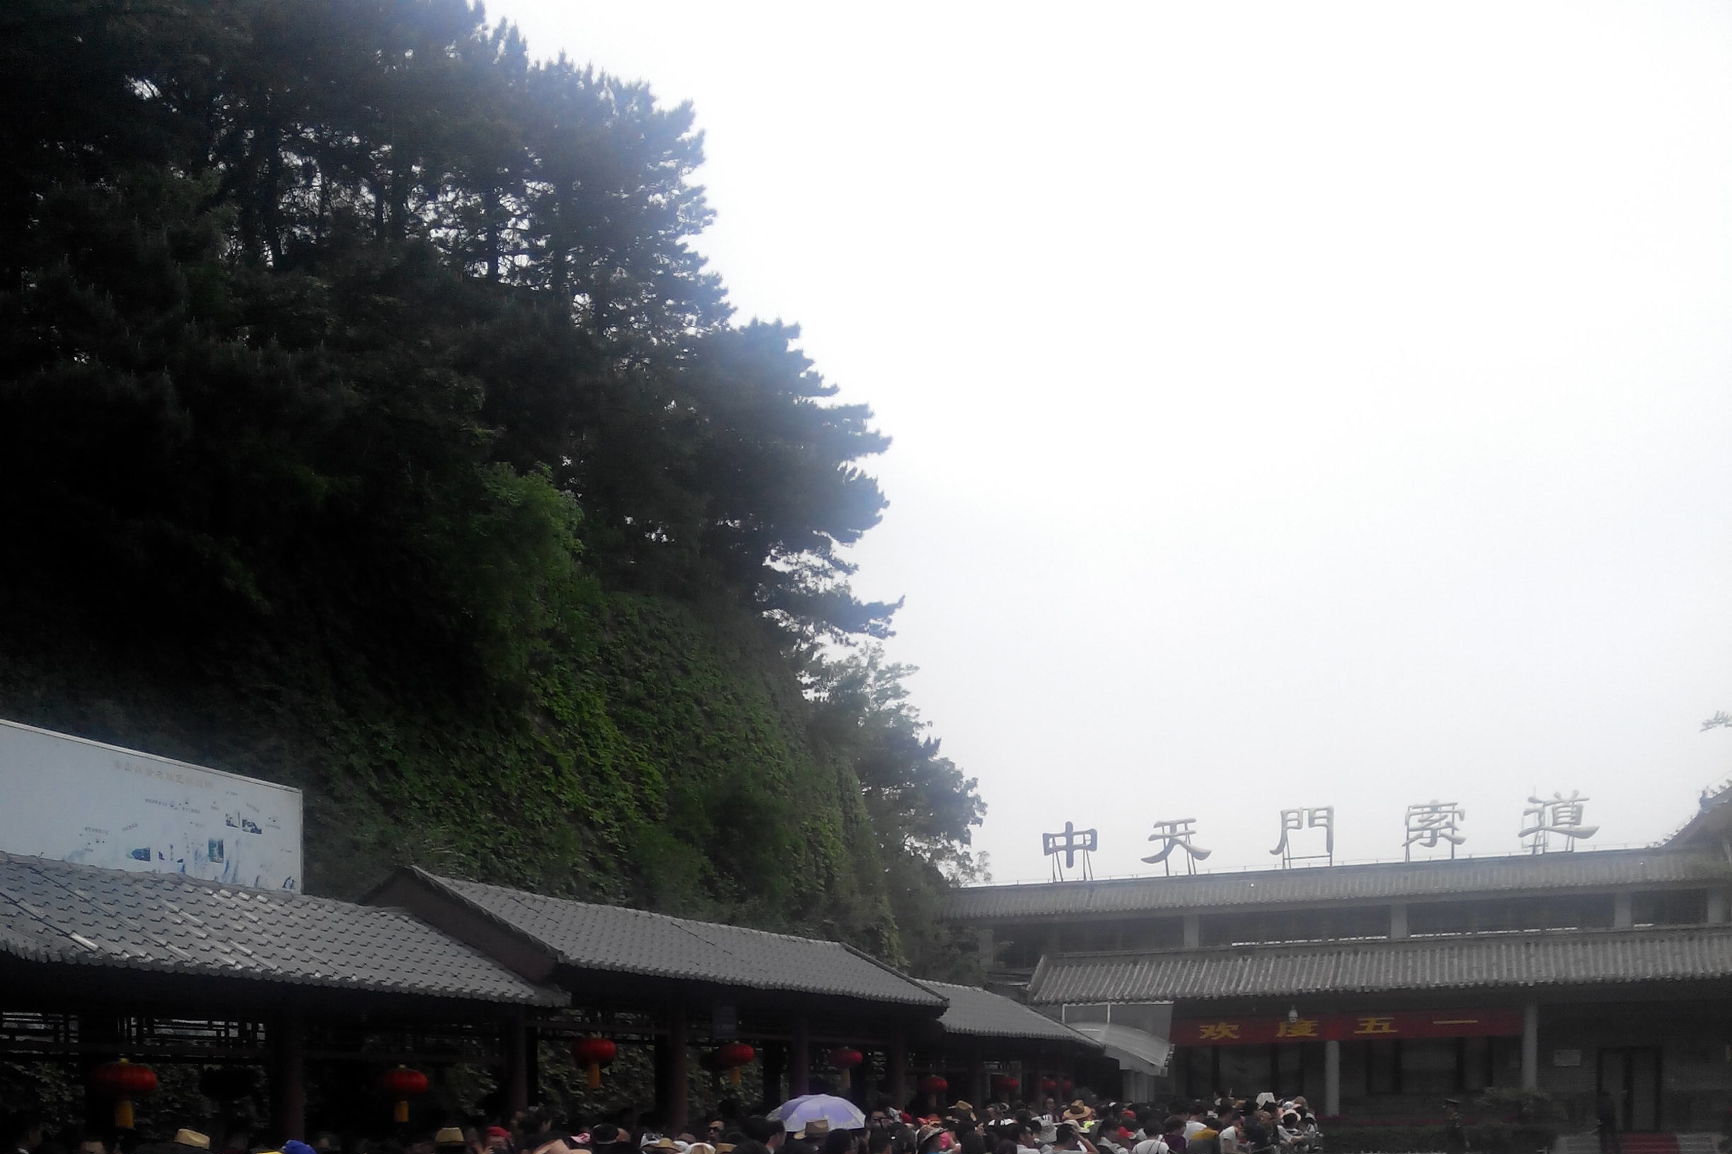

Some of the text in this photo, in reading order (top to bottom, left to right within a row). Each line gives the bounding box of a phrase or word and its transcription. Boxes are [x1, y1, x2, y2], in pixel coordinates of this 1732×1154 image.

[1042, 790, 1599, 868] 中天門索道
[1199, 1016, 1479, 1040] 欢度五一
